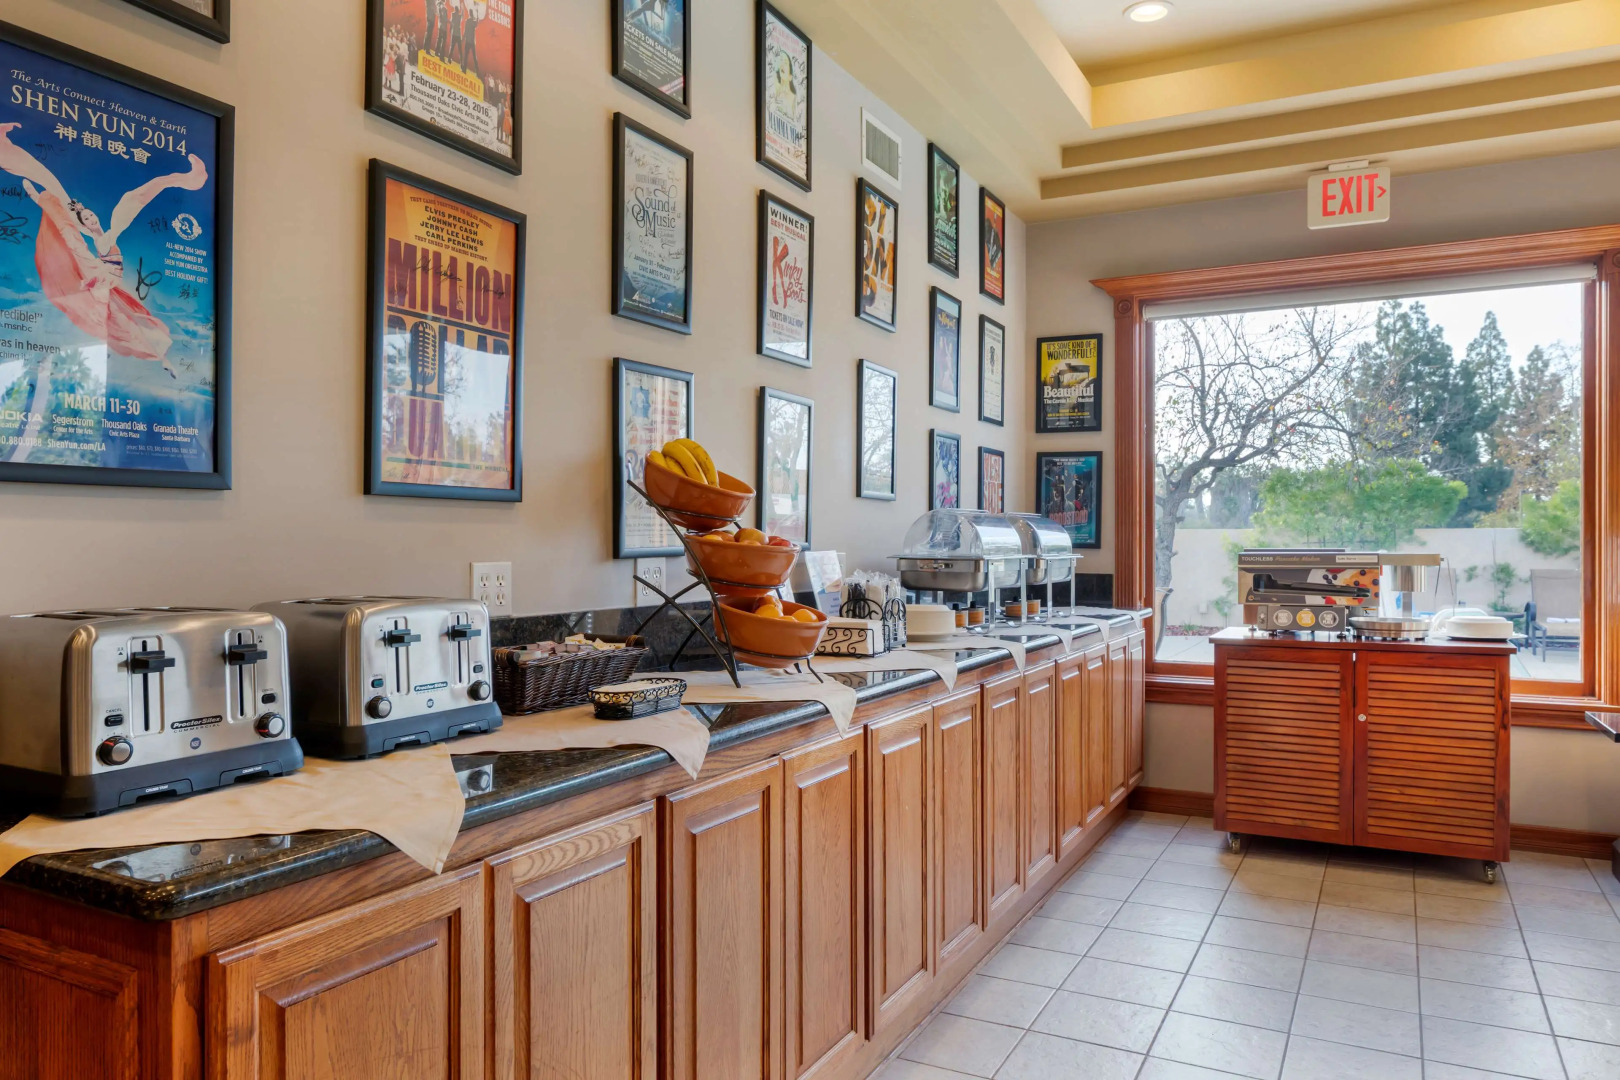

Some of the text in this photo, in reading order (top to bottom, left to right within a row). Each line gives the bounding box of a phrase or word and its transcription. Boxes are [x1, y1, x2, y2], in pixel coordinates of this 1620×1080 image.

[654, 42, 667, 56] SALE
[422, 56, 442, 72] BEST
[443, 67, 480, 94] MUSICAL!
[10, 69, 187, 135] The Arts Connect Heaven & Earth
[411, 71, 446, 98] February
[448, 90, 470, 110] 23-28,
[472, 102, 490, 118] 2016
[411, 84, 489, 127] Thousand Oaks Civic Arts Plaza
[11, 84, 187, 156] SHEN YUN 2014
[1322, 173, 1379, 217] EXIT
[424, 206, 480, 230] ELVIS PRESLEY
[427, 215, 478, 236] JOHNNY CASH
[644, 210, 676, 238] Music
[770, 206, 808, 234] WINNER!
[770, 217, 784, 230] BEST
[420, 220, 484, 246] JERRY LEE LEWIS
[426, 230, 478, 252] CARL PERKINS
[164, 269, 176, 278] BEST
[176, 271, 196, 282] HOLIDAY
[387, 237, 512, 332] MILLION
[786, 282, 807, 304] Boots
[4, 322, 33, 332] msnbc
[15, 338, 24, 350] in
[26, 340, 60, 354] heaven
[1047, 348, 1092, 360] WONDERFUL!
[1056, 341, 1070, 350] SOME
[1072, 340, 1084, 348] KIND
[1085, 340, 1092, 348] OF
[1044, 384, 1094, 398] Beautiful
[64, 392, 140, 415] MARCH 11-30
[52, 414, 199, 436] Segerstrom Thousand Oaks Granada Theatre
[108, 430, 119, 438] Civic
[47, 438, 106, 452] ShenYun.com/LA
